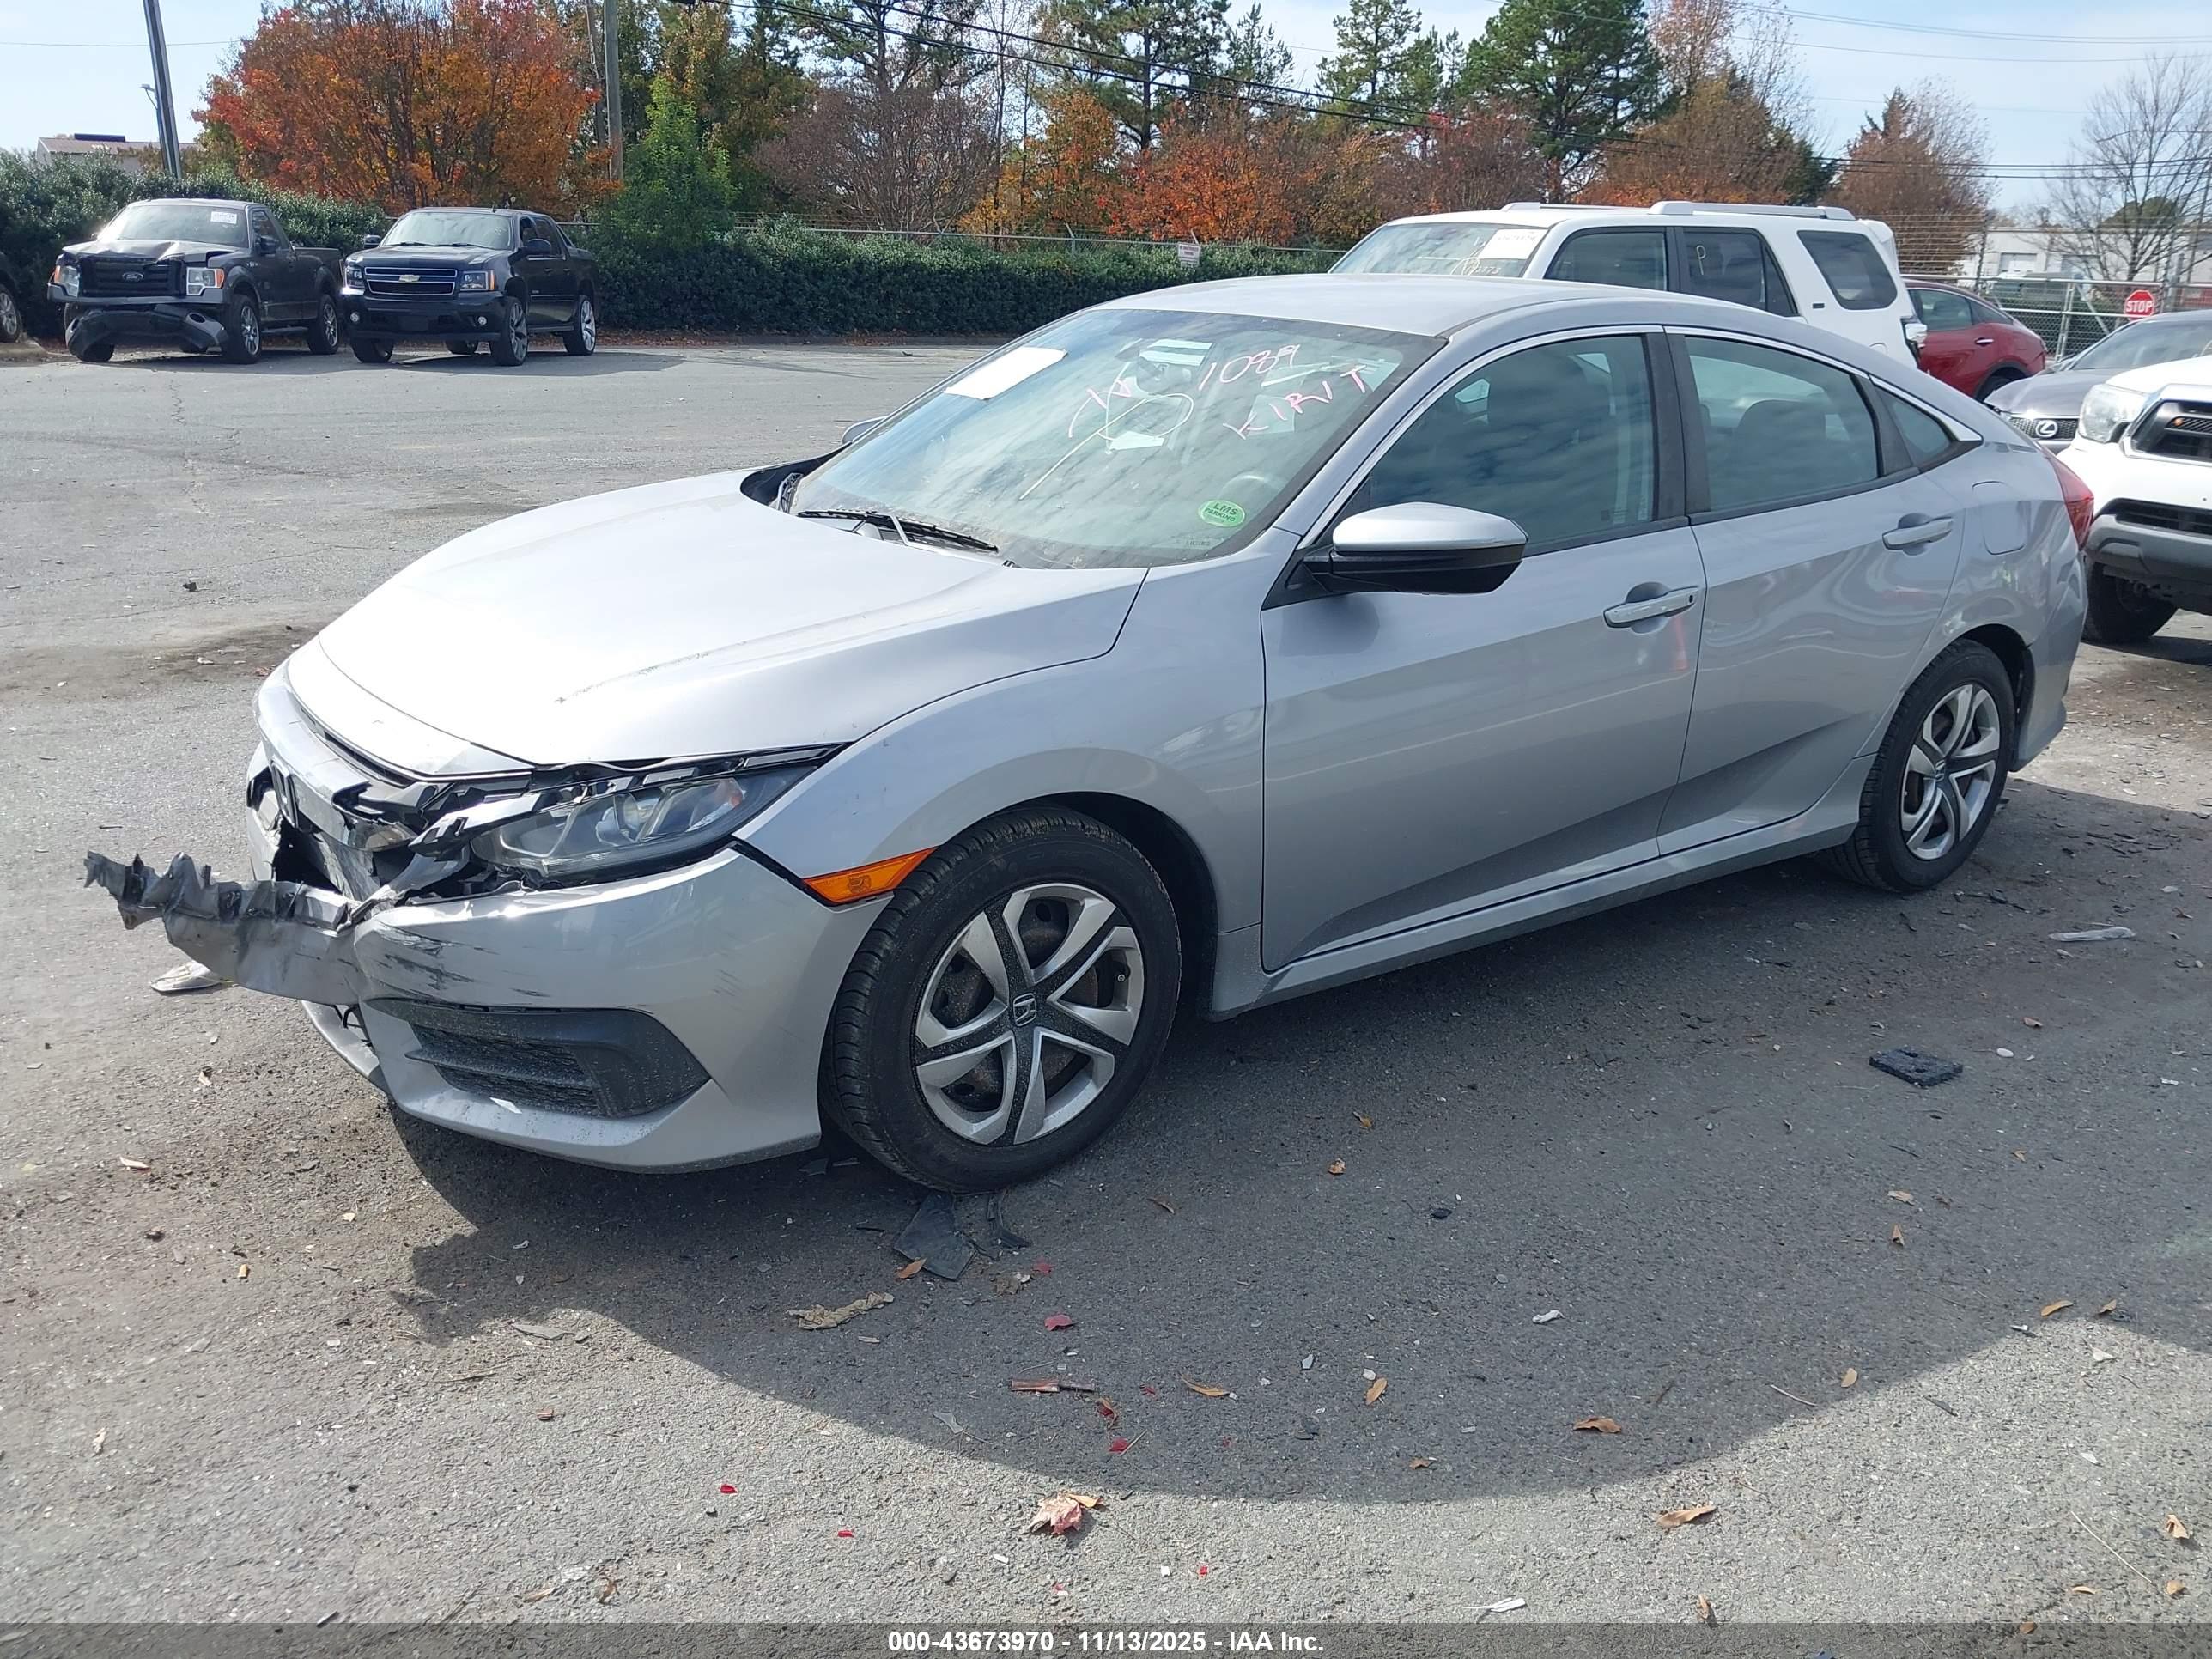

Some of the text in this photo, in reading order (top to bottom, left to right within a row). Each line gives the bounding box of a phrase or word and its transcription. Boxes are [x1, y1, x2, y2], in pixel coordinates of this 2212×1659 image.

[2125, 300, 2153, 313] STOP
[1198, 343, 1301, 392] 1089
[1205, 508, 1236, 522] PARKING
[1213, 503, 1238, 516] LMS
